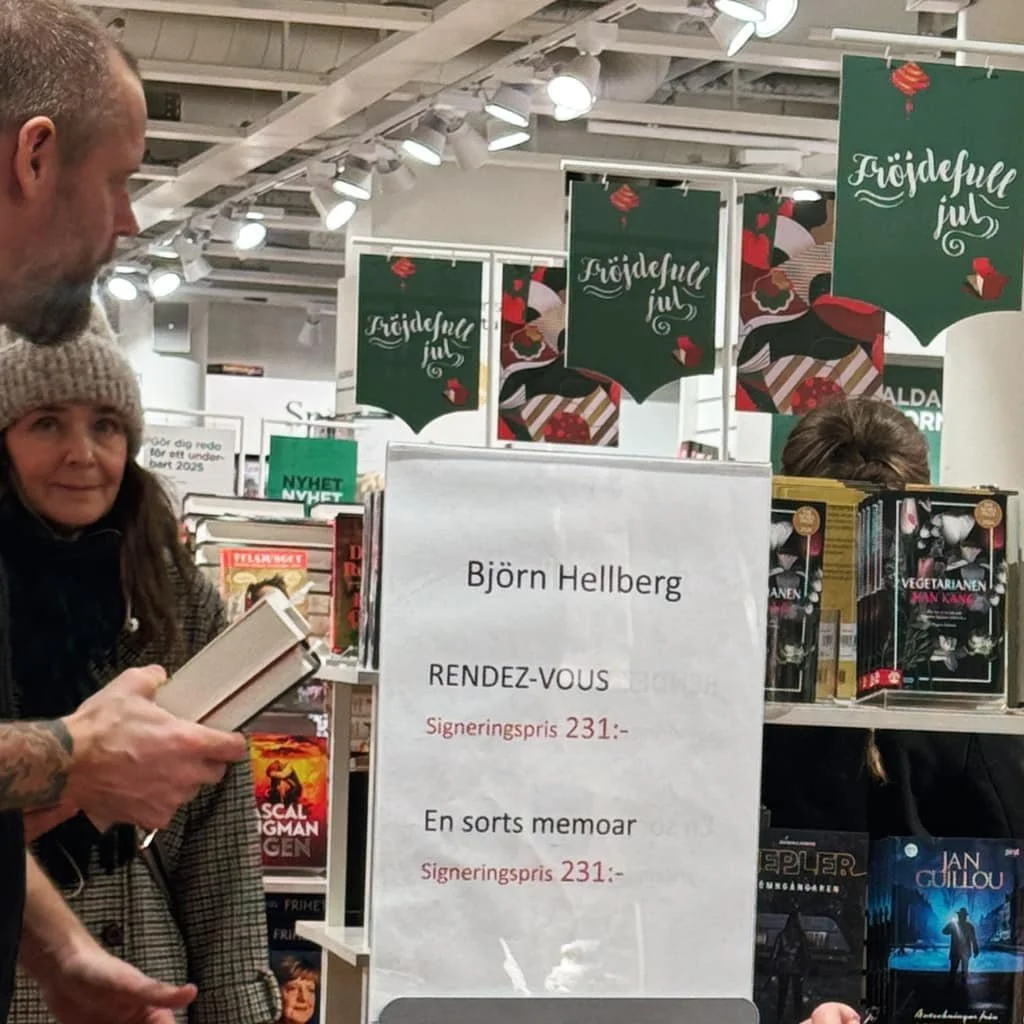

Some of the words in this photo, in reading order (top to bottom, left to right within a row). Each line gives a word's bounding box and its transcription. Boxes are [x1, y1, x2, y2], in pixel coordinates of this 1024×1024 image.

[848, 147, 1018, 199] Fröjdefull
[933, 192, 986, 241] jul
[577, 252, 711, 290] Fröjdefull
[646, 286, 684, 323] jul
[364, 310, 475, 343] Fröjdefull
[169, 449, 185, 458] ett
[174, 439, 193, 451] dig
[176, 461, 205, 472] 2025
[282, 475, 343, 492] NYHET
[467, 560, 546, 595] Björn
[558, 563, 683, 603] Hellberg
[901, 578, 987, 591] VEGETARIANEN
[429, 664, 611, 692] RENDEZ-VOUS
[425, 717, 558, 741] Signeringspris
[565, 716, 629, 740] 231:-
[255, 802, 307, 820] ASCAL
[424, 809, 454, 833] En
[462, 812, 523, 834] sorts
[532, 816, 637, 836] memoar
[263, 838, 312, 858] GEN
[421, 863, 553, 885] Signeringspris
[561, 860, 625, 883] 231:-
[759, 848, 868, 877] EPLER
[942, 850, 981, 874] JAN
[915, 870, 1004, 890] GUILLOU
